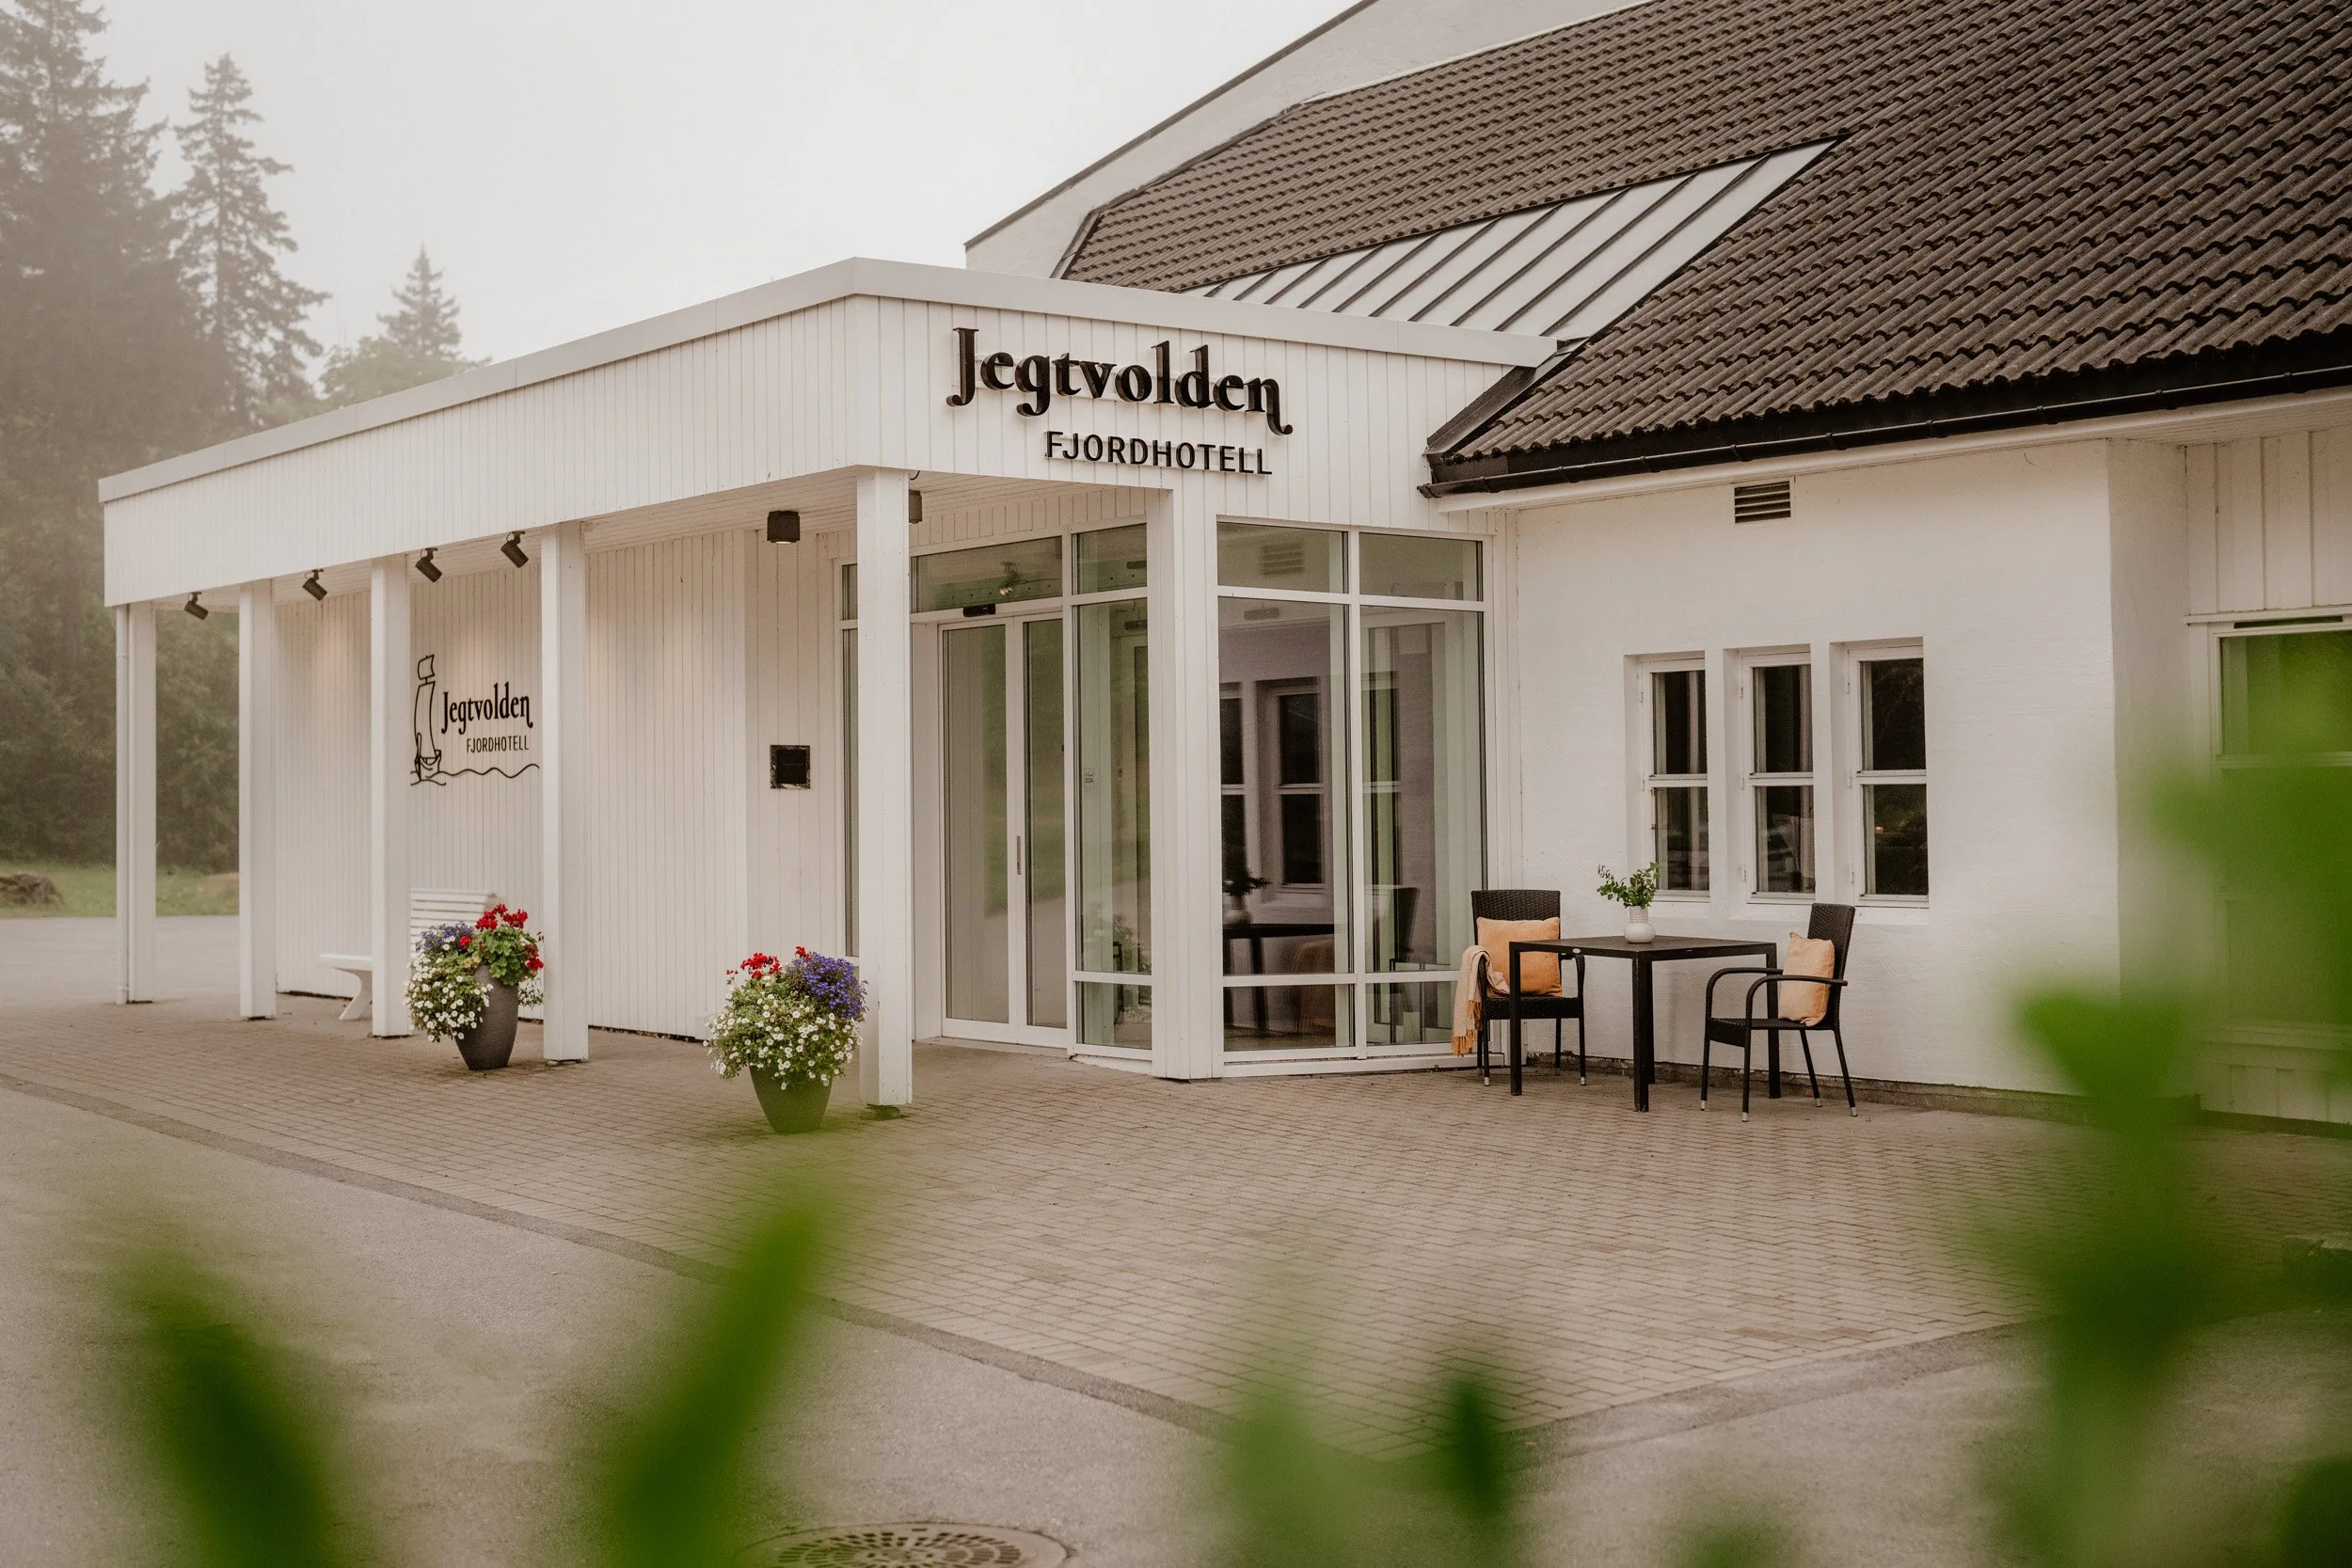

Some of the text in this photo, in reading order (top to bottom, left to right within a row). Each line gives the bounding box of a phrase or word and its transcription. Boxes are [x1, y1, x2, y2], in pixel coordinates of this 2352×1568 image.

[946, 327, 1293, 436] Jegtvolden
[1045, 430, 1273, 475] FJORDHOTELL
[440, 681, 533, 735] Jegtvolden
[466, 735, 530, 753] FJORDHOTELL
